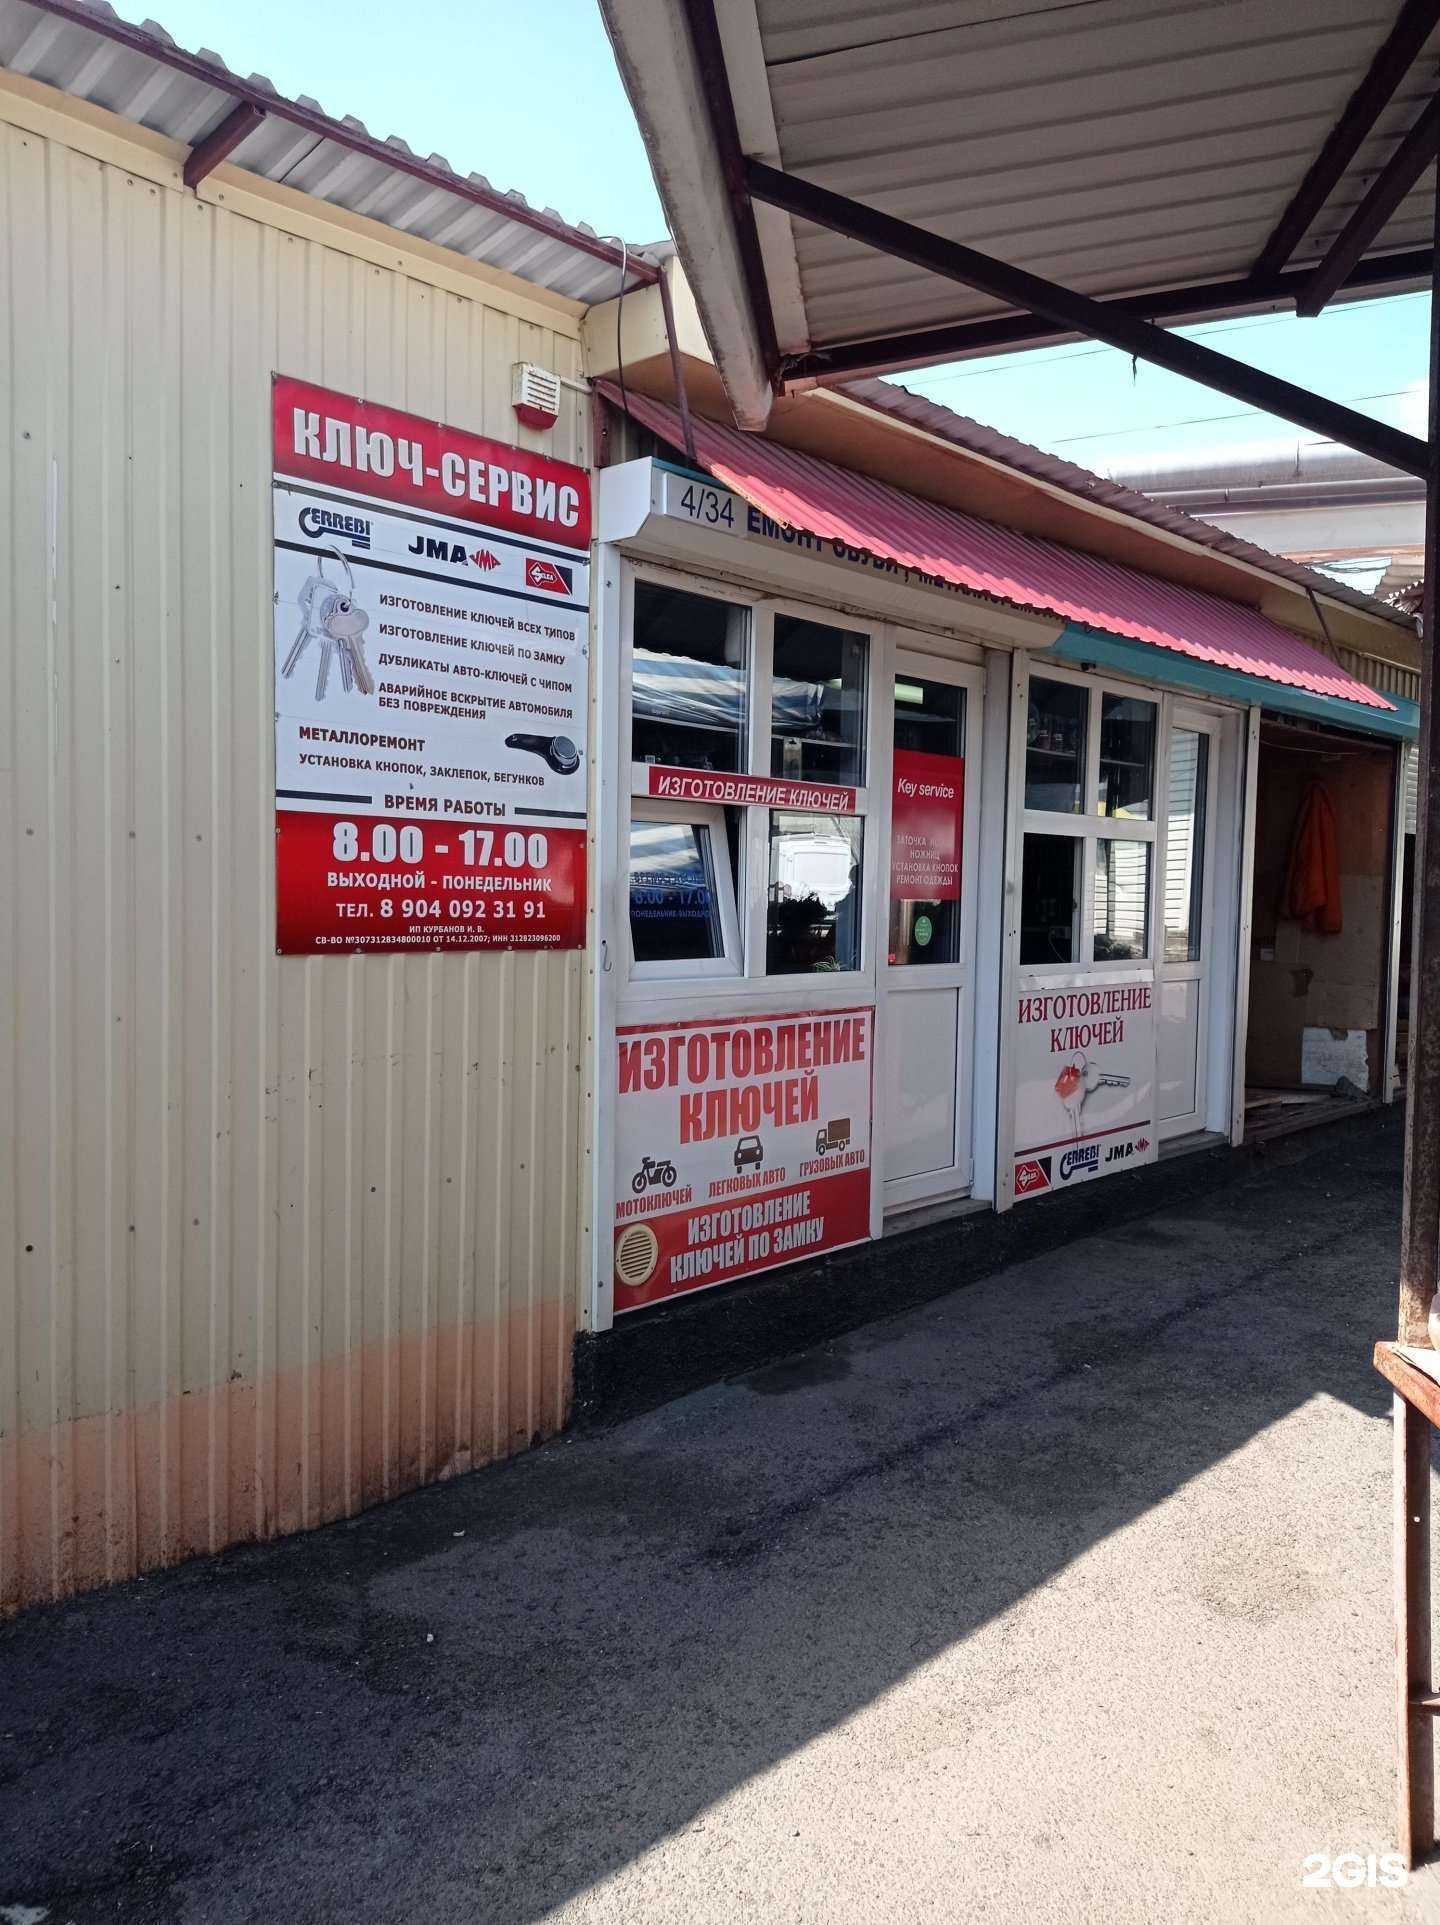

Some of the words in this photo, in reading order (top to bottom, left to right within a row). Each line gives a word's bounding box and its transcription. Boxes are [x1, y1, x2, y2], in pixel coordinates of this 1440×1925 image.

[293, 407, 580, 528] КЛЮЧ-СЕРВИС
[298, 506, 372, 539] CERREBI
[680, 485, 735, 530] 4/34
[408, 535, 469, 566] JMA
[379, 594, 468, 620] ИЗГОТОВЛЕНИЕ
[470, 612, 515, 629] КЛЮЧЕЙ
[517, 621, 542, 635] ВСЕХ
[544, 626, 575, 641] ТИПОВ
[379, 623, 468, 648] ИЗГОТОВЛЕНИЕ
[470, 641, 515, 656] КЛЮЧЕЙ
[517, 648, 532, 659] ПО
[534, 651, 565, 665] ЗАМКУ
[378, 653, 450, 673] ДУБЛИКАТЫ
[453, 664, 528, 685] АВТО-КЛЮЧЕЙ
[530, 678, 537, 687] С
[539, 679, 572, 692] ЧИПОМ
[378, 697, 400, 709] БЕЗ
[403, 699, 486, 720] ПОВРЕЖДЕНИЯ
[379, 682, 448, 701] АВАРИЙНОЕ
[451, 692, 506, 709] ВСКРЫТИЕ
[508, 701, 573, 719] АВТОМОБИЛЯ
[299, 726, 426, 752] МЕТАЛЛОРЕМОНТ
[299, 753, 372, 770] УСТАНОВКА
[376, 760, 427, 777] КНОПОК,
[430, 765, 491, 782] ЗАКЛЕПОК,
[494, 772, 545, 786] БЕГУНКОВ
[658, 776, 786, 805] ИЗГОТОВЛЕНИЕ
[789, 788, 849, 811] КЛЮЧЕЙ
[897, 777, 917, 797] Key
[918, 783, 954, 798] service
[384, 794, 438, 812] ВРЕМЯ
[444, 799, 506, 817] РАБОТЫ
[333, 821, 424, 864] 8.00
[435, 844, 449, 854] -
[458, 829, 548, 869] 17.00
[327, 870, 426, 890] ВЫХОДНОЙ
[443, 874, 552, 892] ПОНЕДЕЛЬНИК
[896, 874, 922, 885] РЕМОНТ
[336, 903, 374, 918] ТЕЛ.
[380, 899, 393, 918] 8
[402, 899, 442, 918] 904
[449, 900, 486, 918] 092
[493, 900, 516, 918] 31
[523, 901, 546, 918] 91
[315, 935, 343, 945] СВ-ВО
[433, 935, 444, 943] ОТ
[446, 934, 490, 944] 14.12.2007;
[492, 934, 508, 943] ИНН
[409, 925, 421, 933] ИП
[423, 925, 465, 933] КУРБАНОВ
[1018, 987, 1152, 1024] ИЗГОТОВЛЕНИЕ
[1050, 1016, 1124, 1052] КЛЮЧЕЙ
[618, 1017, 866, 1094] ИЗГОТОВЛЕНИЕ
[680, 1068, 819, 1145] КЛЮЧЕЙ
[800, 1154, 843, 1177] ГРУЗОВЫХ
[845, 1151, 865, 1170] АВТО
[1059, 1144, 1101, 1180] CERREBI
[1105, 1142, 1135, 1162] JMA
[708, 1173, 761, 1198] ЛЕГКОВЫХ
[762, 1168, 786, 1188] АВТО
[616, 1183, 692, 1219] МОТОКЛЮЧЕЙ
[688, 1190, 812, 1245] ИЗГОТОВЛЕНИЕ
[670, 1233, 745, 1283] КЛЮЧЕЙ
[749, 1231, 770, 1260] ПО
[773, 1216, 825, 1254] ЗАМКУ
